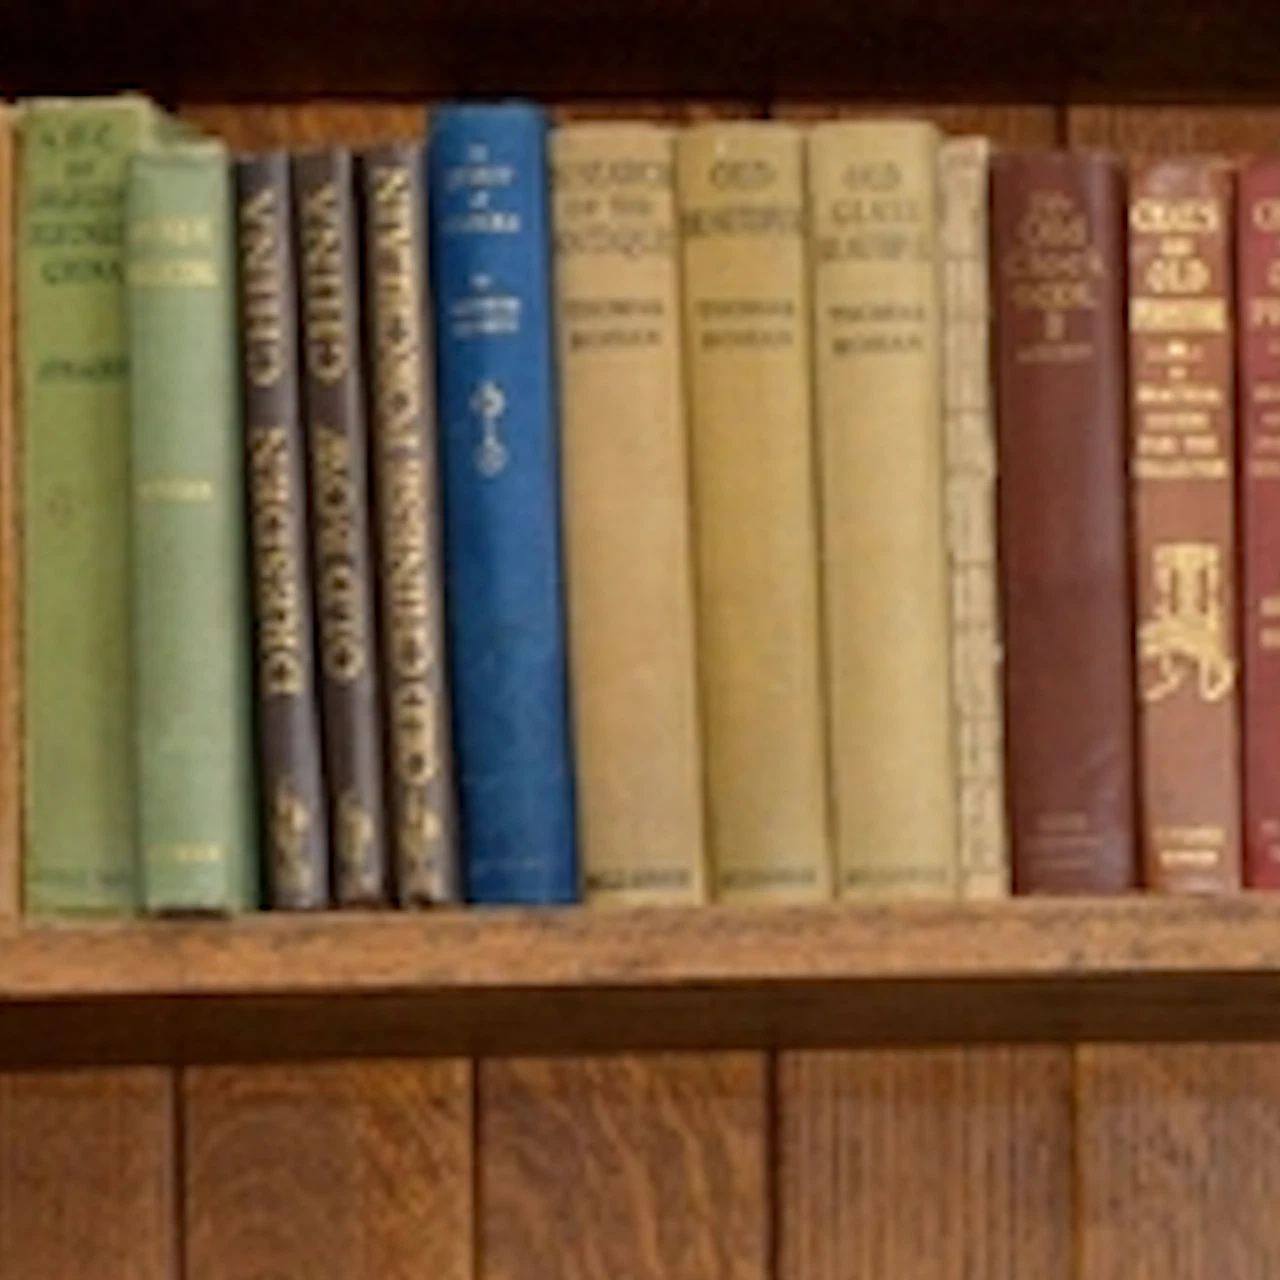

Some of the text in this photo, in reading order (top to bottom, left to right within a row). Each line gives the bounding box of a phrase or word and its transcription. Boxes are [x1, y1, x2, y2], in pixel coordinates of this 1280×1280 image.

[708, 161, 772, 188] OLD
[1145, 260, 1211, 294] OLD
[242, 187, 305, 699] DRESDEN CHINA
[303, 186, 366, 683] OLD BOW CHINA
[370, 166, 434, 786] OLD CHINESE PORCELAIN
